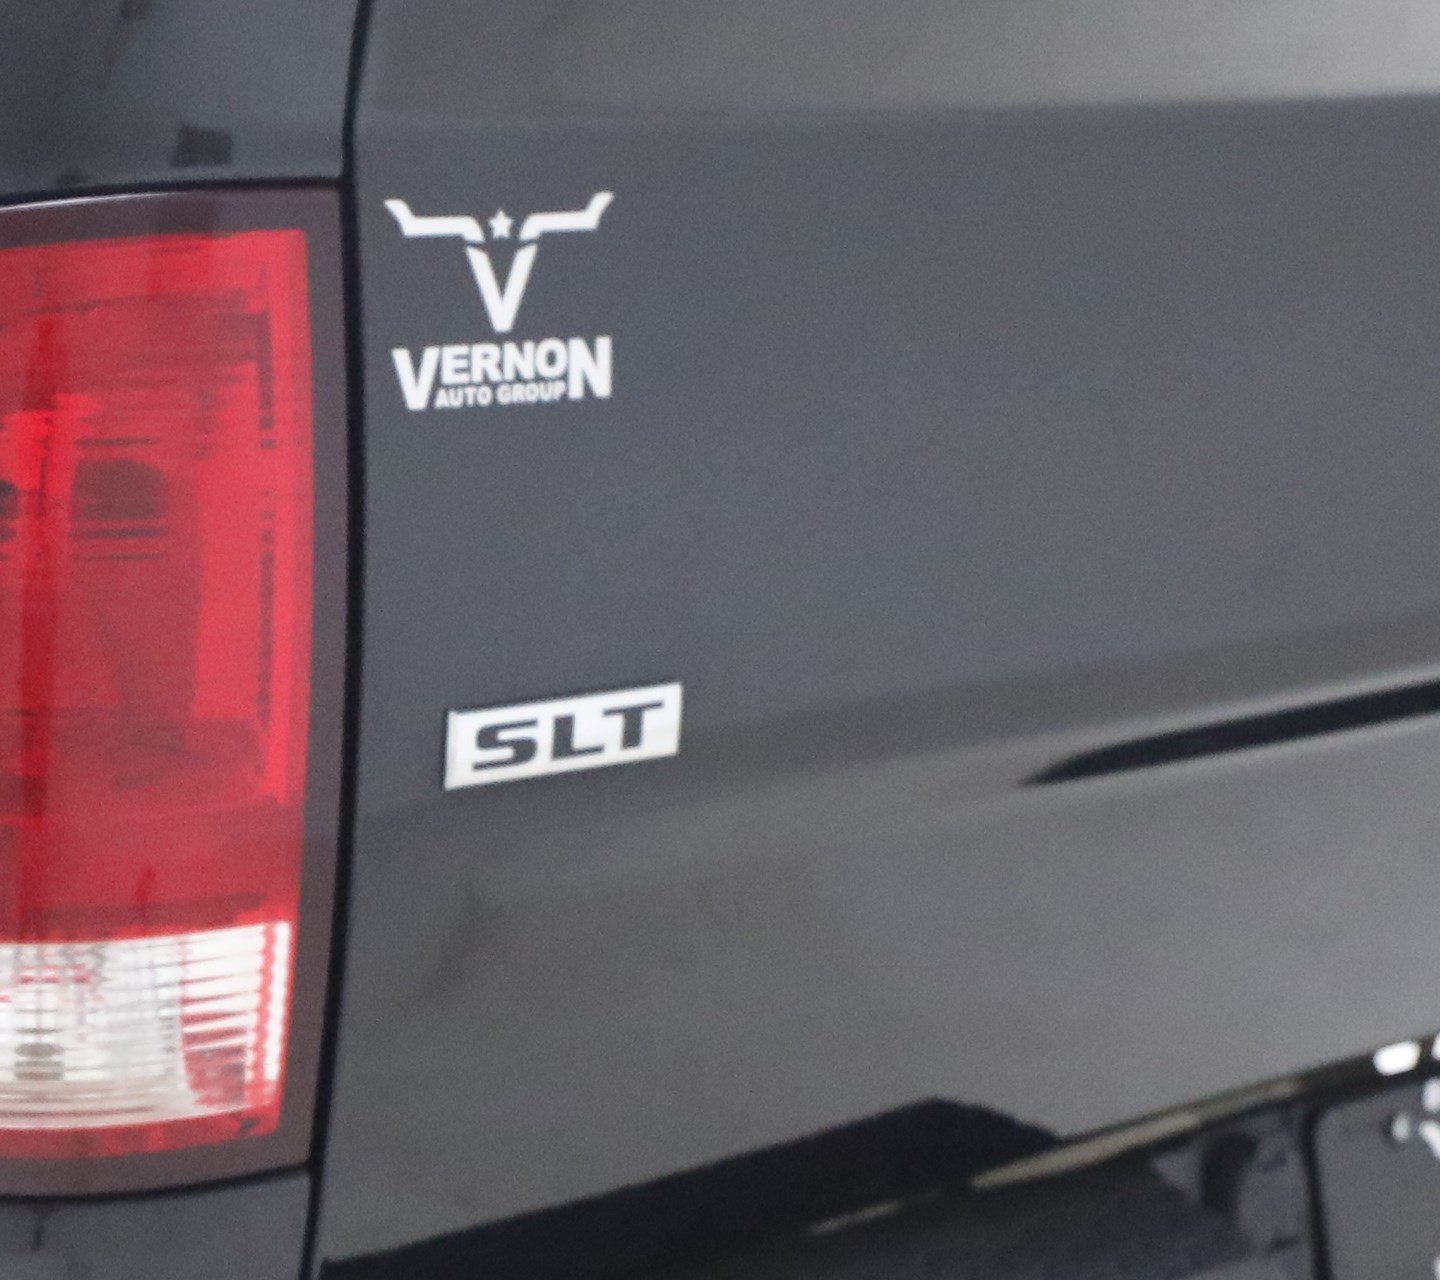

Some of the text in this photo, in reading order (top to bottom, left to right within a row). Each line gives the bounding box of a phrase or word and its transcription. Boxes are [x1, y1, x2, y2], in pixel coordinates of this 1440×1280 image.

[392, 336, 612, 410] VERNON
[434, 381, 566, 408] AUTO GROUP
[473, 700, 664, 770] SLT
